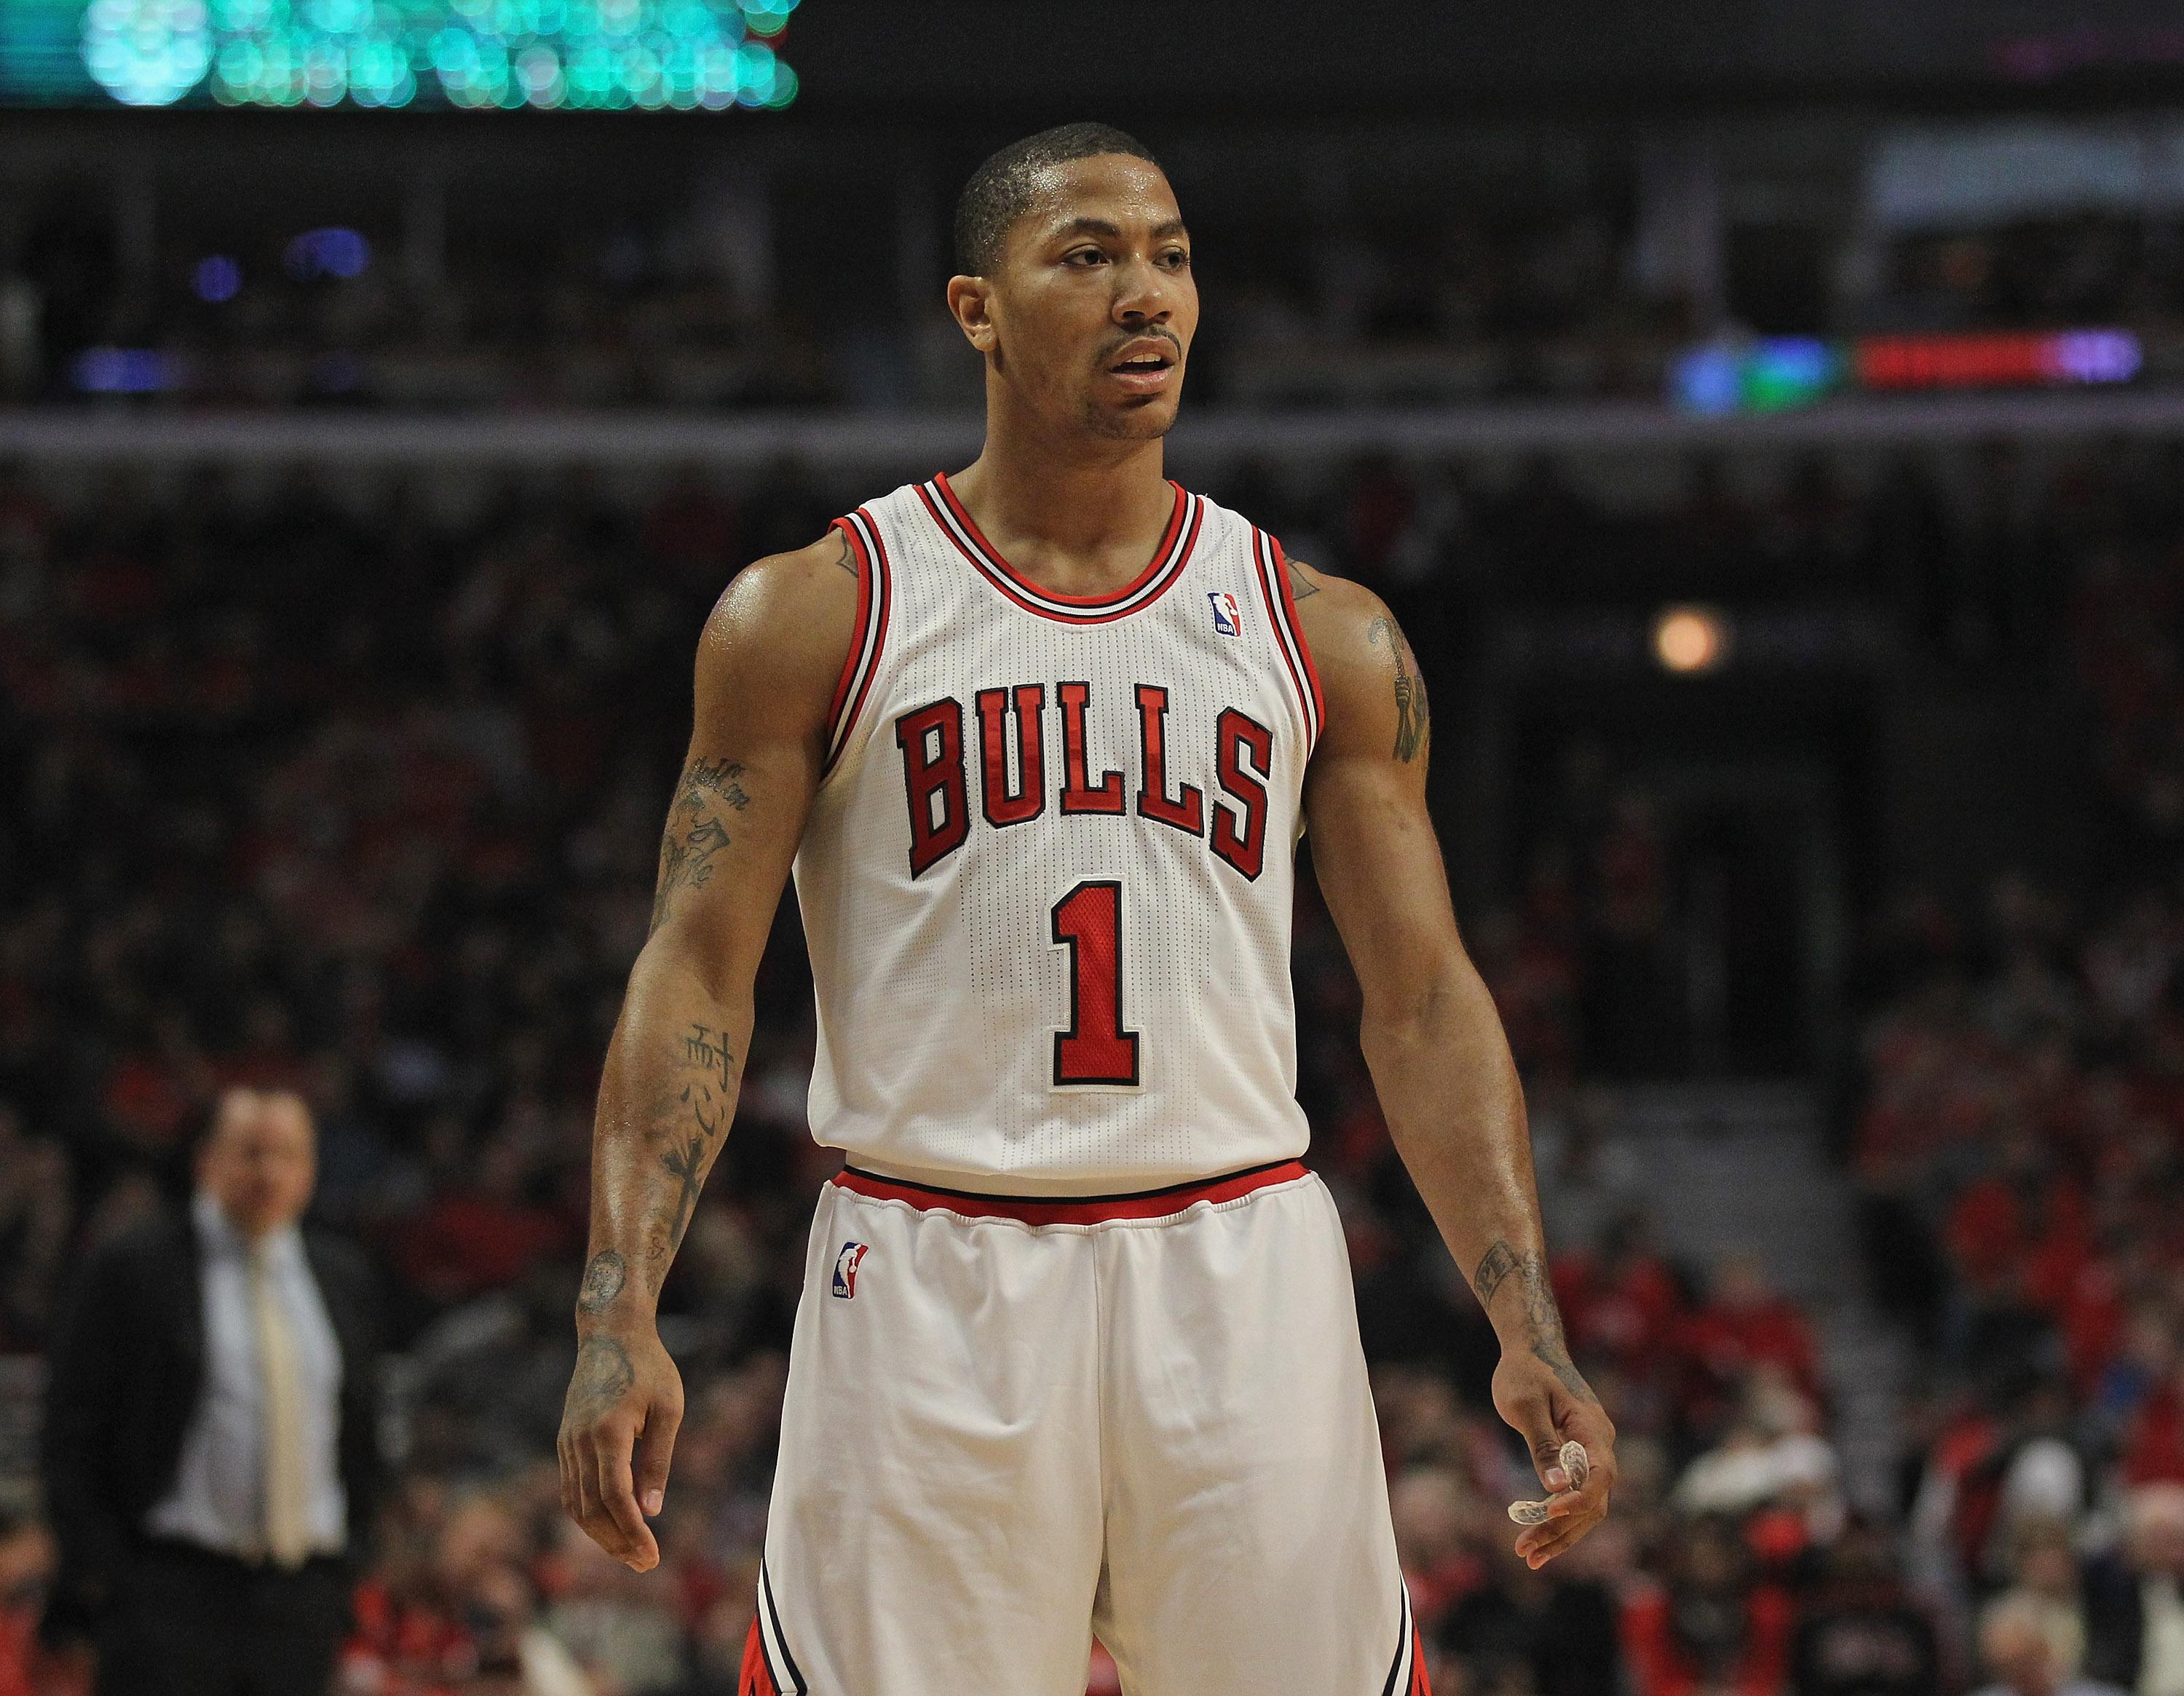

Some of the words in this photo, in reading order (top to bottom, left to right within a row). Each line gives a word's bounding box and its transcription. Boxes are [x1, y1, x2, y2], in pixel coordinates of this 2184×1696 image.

[1217, 623, 1233, 633] NBA
[895, 681, 1273, 883] BULLS
[1051, 880, 1140, 1086] 1
[834, 1285, 847, 1296] NBA
